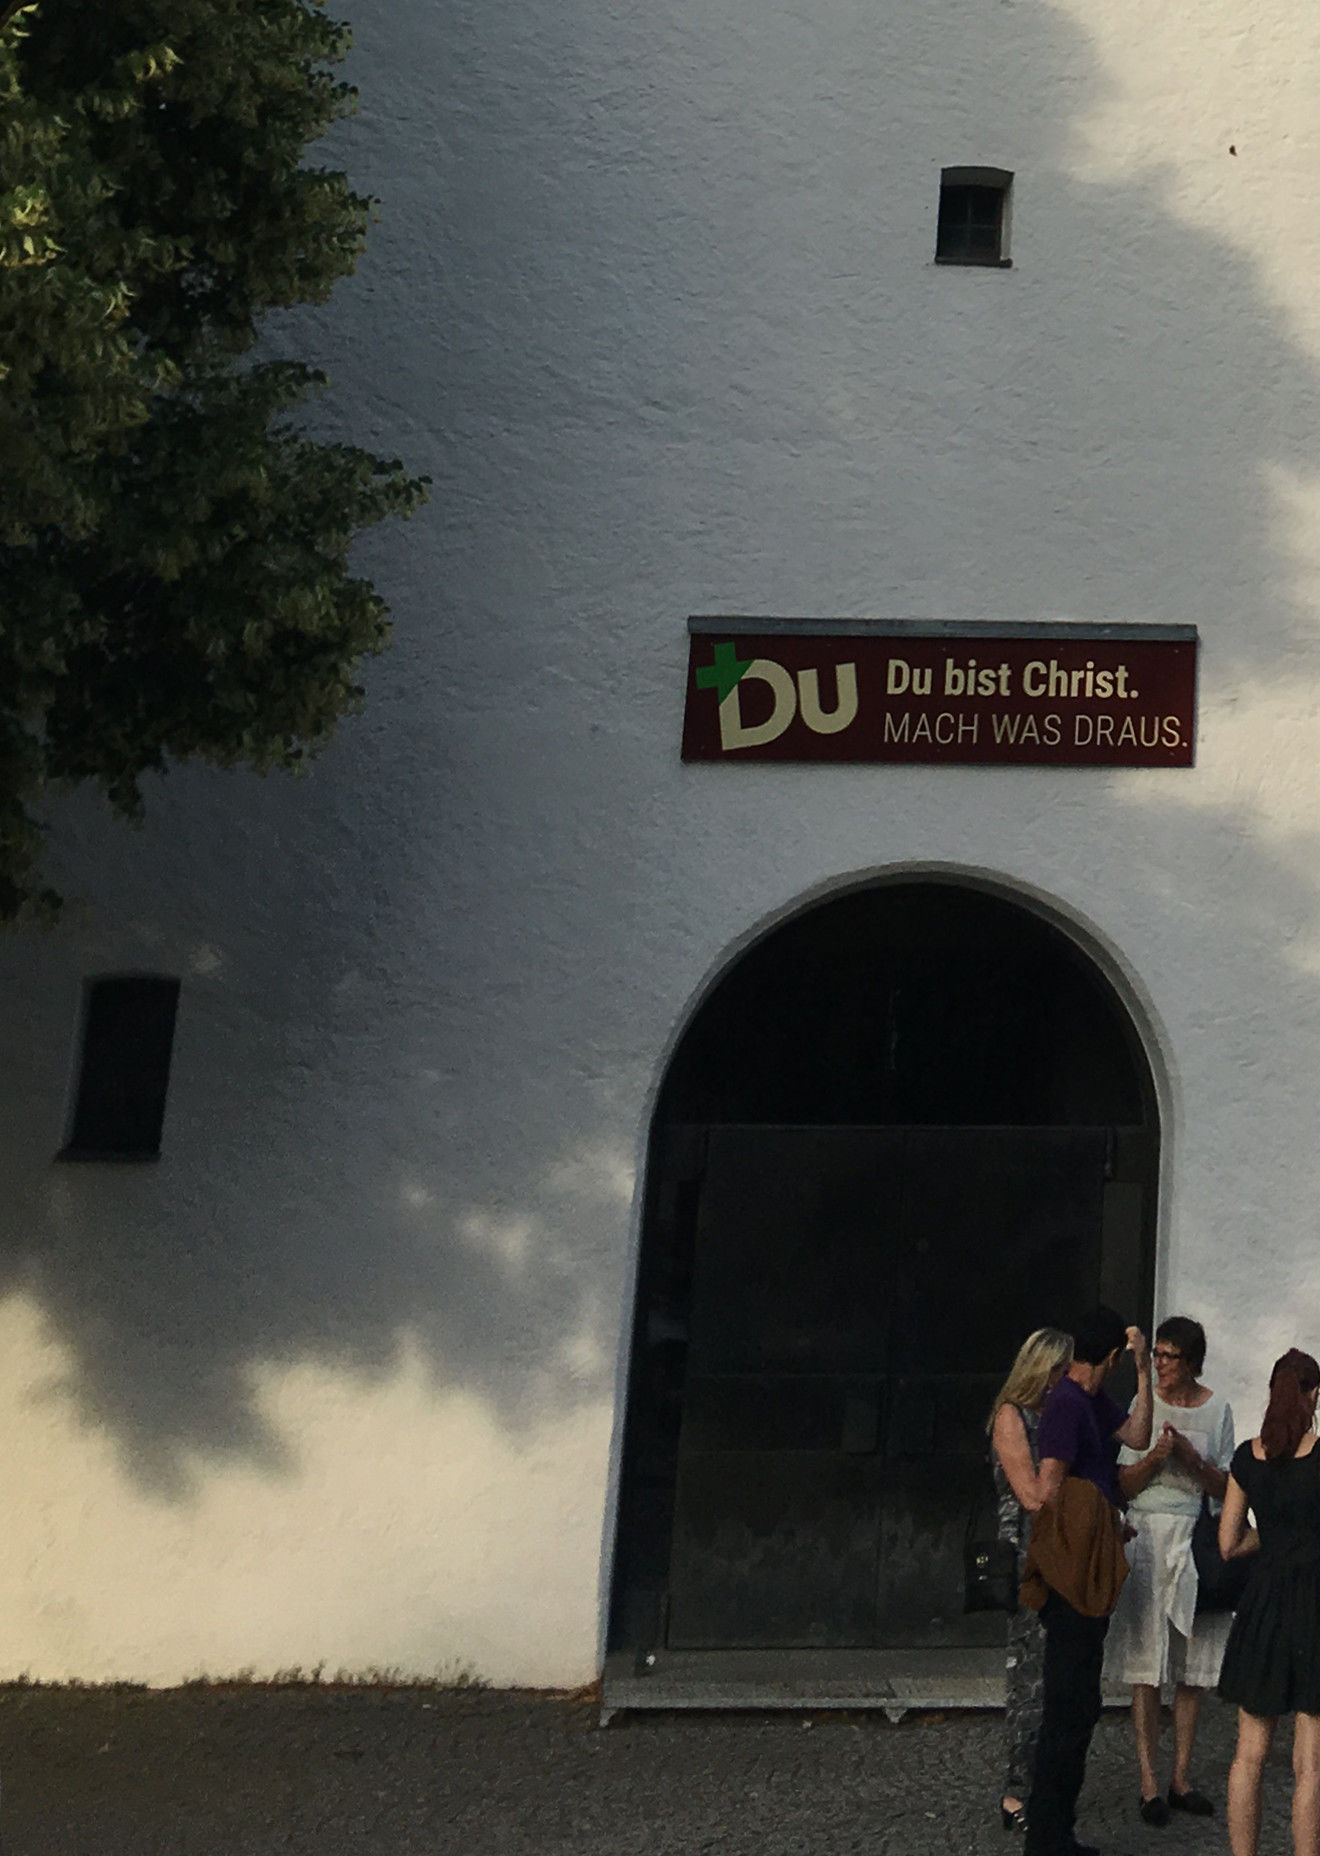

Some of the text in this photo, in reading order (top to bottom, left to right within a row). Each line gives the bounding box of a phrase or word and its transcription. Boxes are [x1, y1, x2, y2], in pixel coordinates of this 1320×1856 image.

[886, 658, 1139, 699] Du bist Christ.
[884, 712, 1188, 748] MACH WAS DRAUS.
